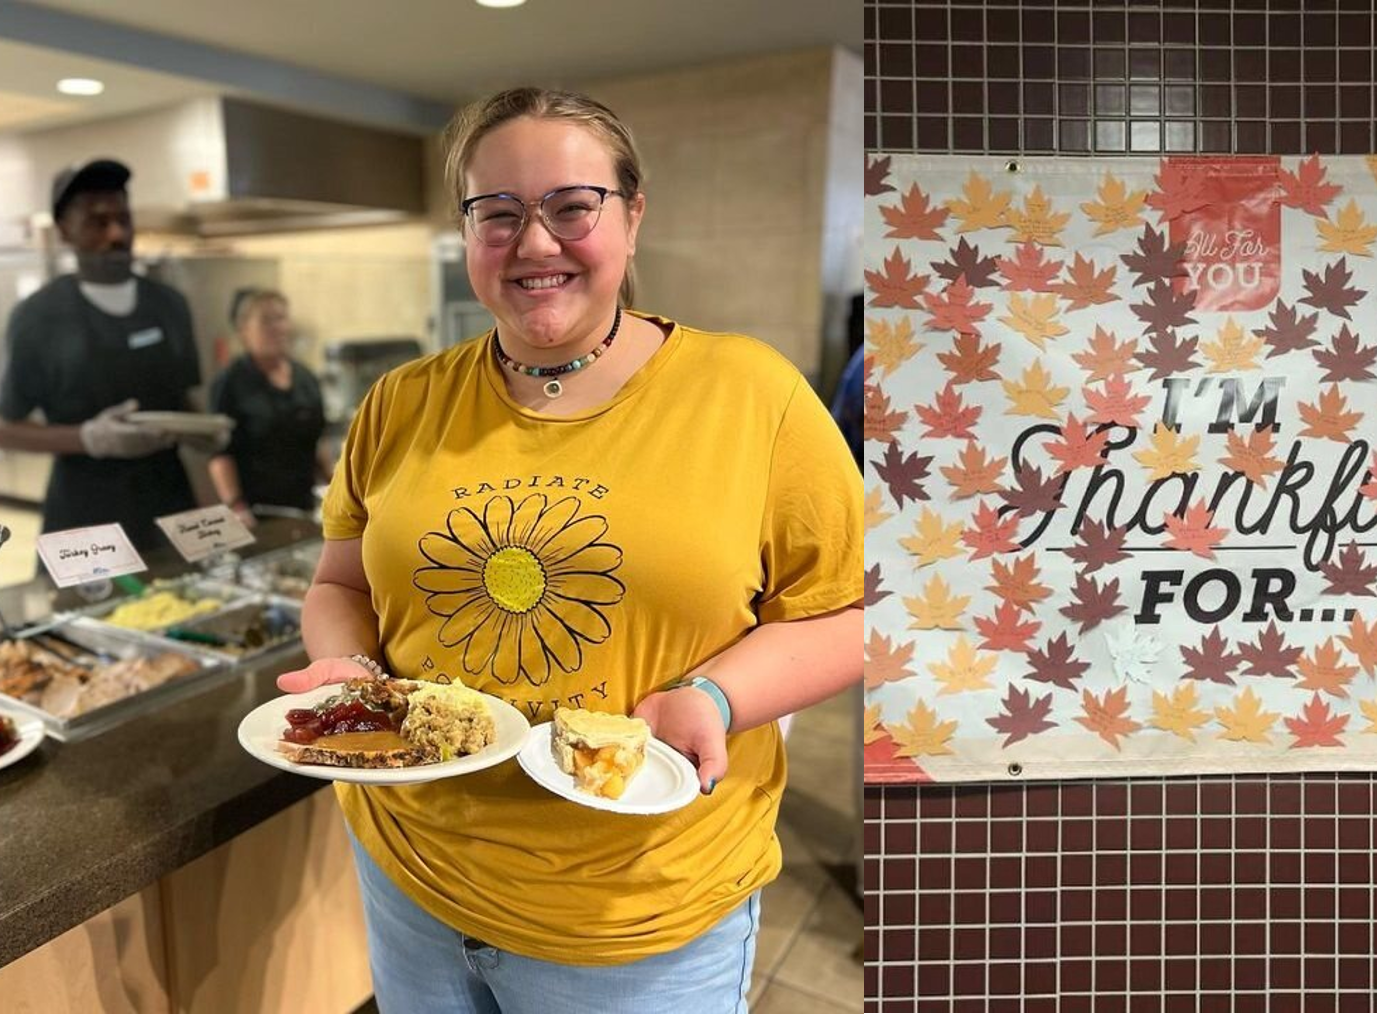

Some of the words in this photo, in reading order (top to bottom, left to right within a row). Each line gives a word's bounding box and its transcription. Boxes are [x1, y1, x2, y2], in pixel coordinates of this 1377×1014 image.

[1183, 230, 1218, 259] All
[1220, 230, 1269, 260] For
[1183, 262, 1264, 290] YOU
[1153, 377, 1288, 434] I'M
[450, 476, 610, 500] RADIATE
[1134, 568, 1358, 624] FOR...
